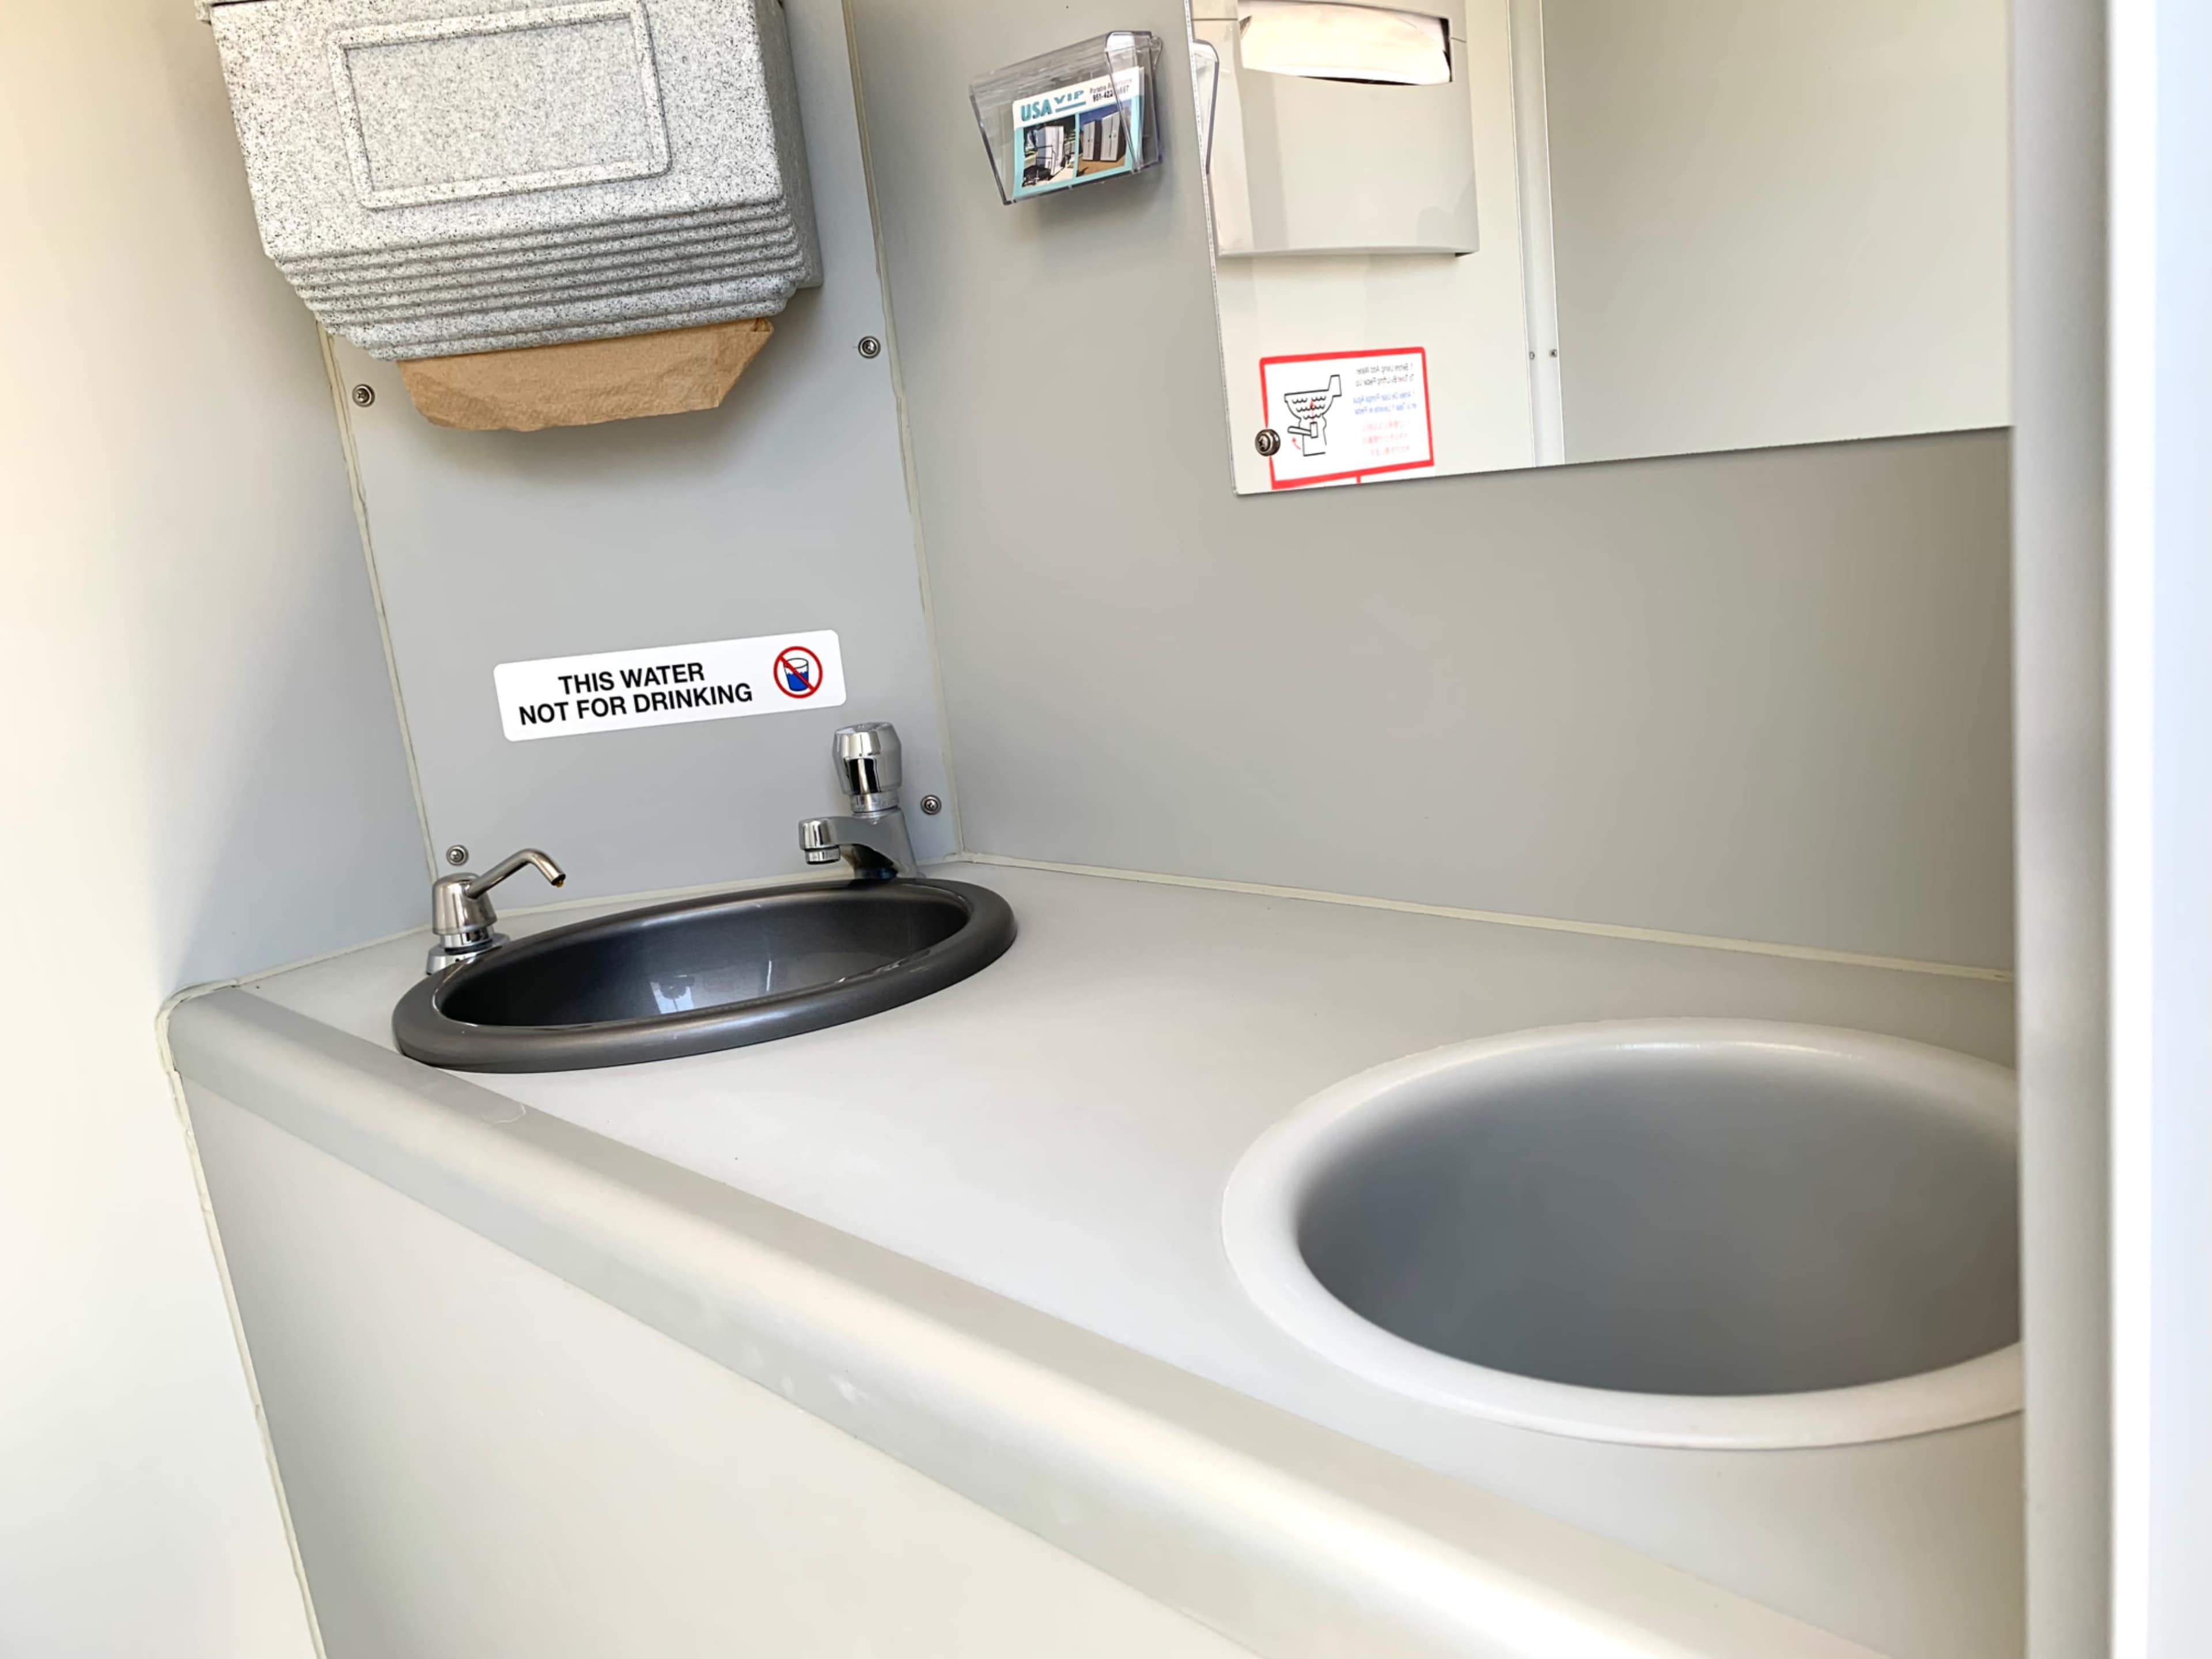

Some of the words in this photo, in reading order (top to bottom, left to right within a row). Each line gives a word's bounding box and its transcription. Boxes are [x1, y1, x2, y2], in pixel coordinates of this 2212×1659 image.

[1020, 99, 1052, 122] USA
[1054, 89, 1084, 105] VIP
[558, 671, 615, 695] THIS
[620, 662, 705, 688] WATER
[519, 702, 569, 725] NOT
[577, 696, 627, 719] FOR
[633, 683, 753, 714] DRINKING
